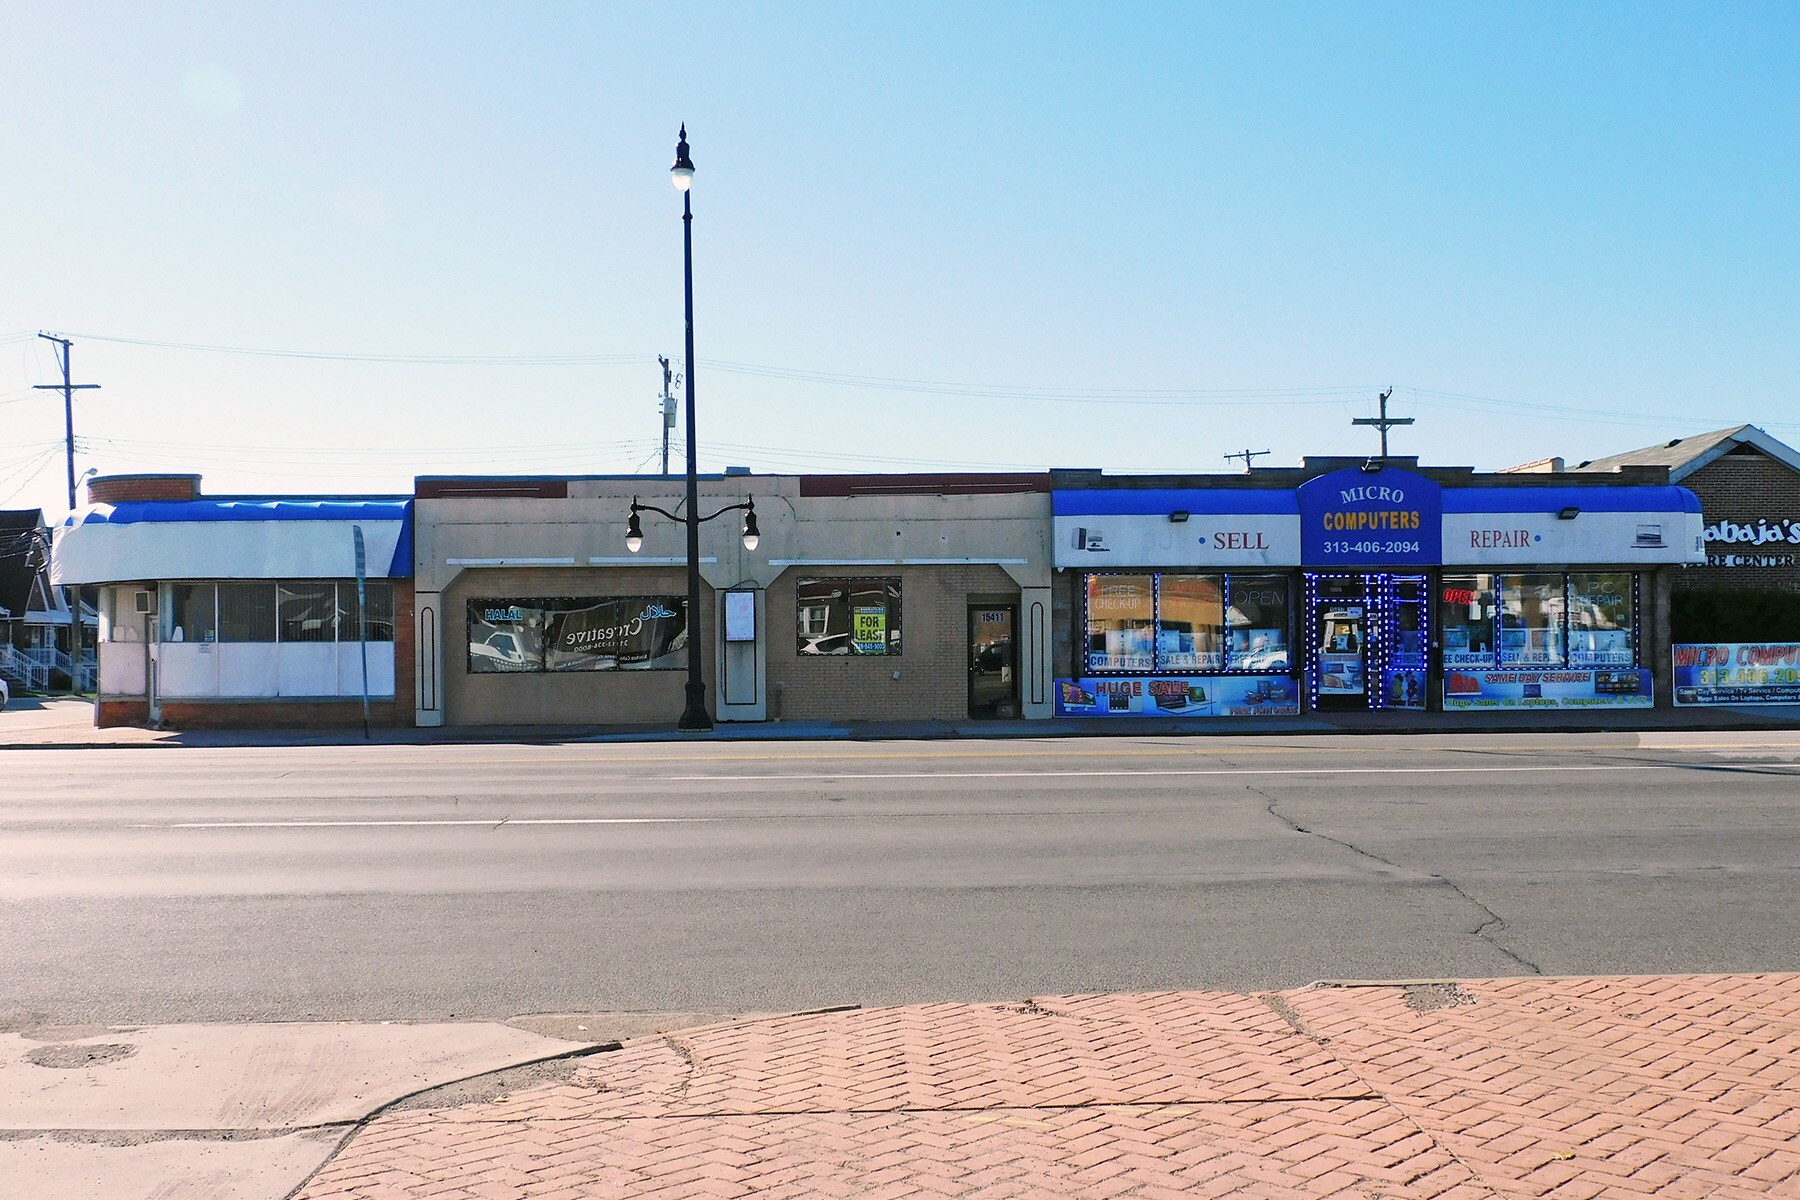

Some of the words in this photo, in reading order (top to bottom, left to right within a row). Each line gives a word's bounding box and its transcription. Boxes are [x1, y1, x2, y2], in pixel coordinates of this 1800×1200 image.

[1340, 486, 1404, 504] MICRO
[1323, 510, 1420, 531] COMPUTERS
[1703, 518, 1800, 545] abaja's
[1213, 532, 1270, 550] SELL
[1470, 530, 1531, 549] REPAIR
[1323, 541, 1420, 553] 313-406-2094
[1733, 554, 1794, 567] CENTER
[1102, 584, 1136, 597] FREE
[1587, 581, 1616, 594] PC
[1094, 597, 1141, 610] CHECK-UP
[1233, 589, 1285, 606] OPEN
[1443, 588, 1477, 606] OPEN
[484, 608, 524, 621] HALAL
[639, 604, 677, 621] حلال
[982, 612, 1004, 622] 15411
[860, 616, 880, 628] FOR
[1091, 655, 1150, 668] COMPUTERS
[1160, 654, 1180, 666] SALE
[1192, 654, 1220, 665] REPAIR
[1455, 654, 1493, 664] CHECK-UP
[1675, 645, 1729, 667] MICRO
[1485, 673, 1517, 684] SAME
[1518, 673, 1541, 684] DAY
[1542, 672, 1592, 683] SERVICE
[1095, 681, 1142, 697] HUGE
[1148, 681, 1190, 697] SALE
